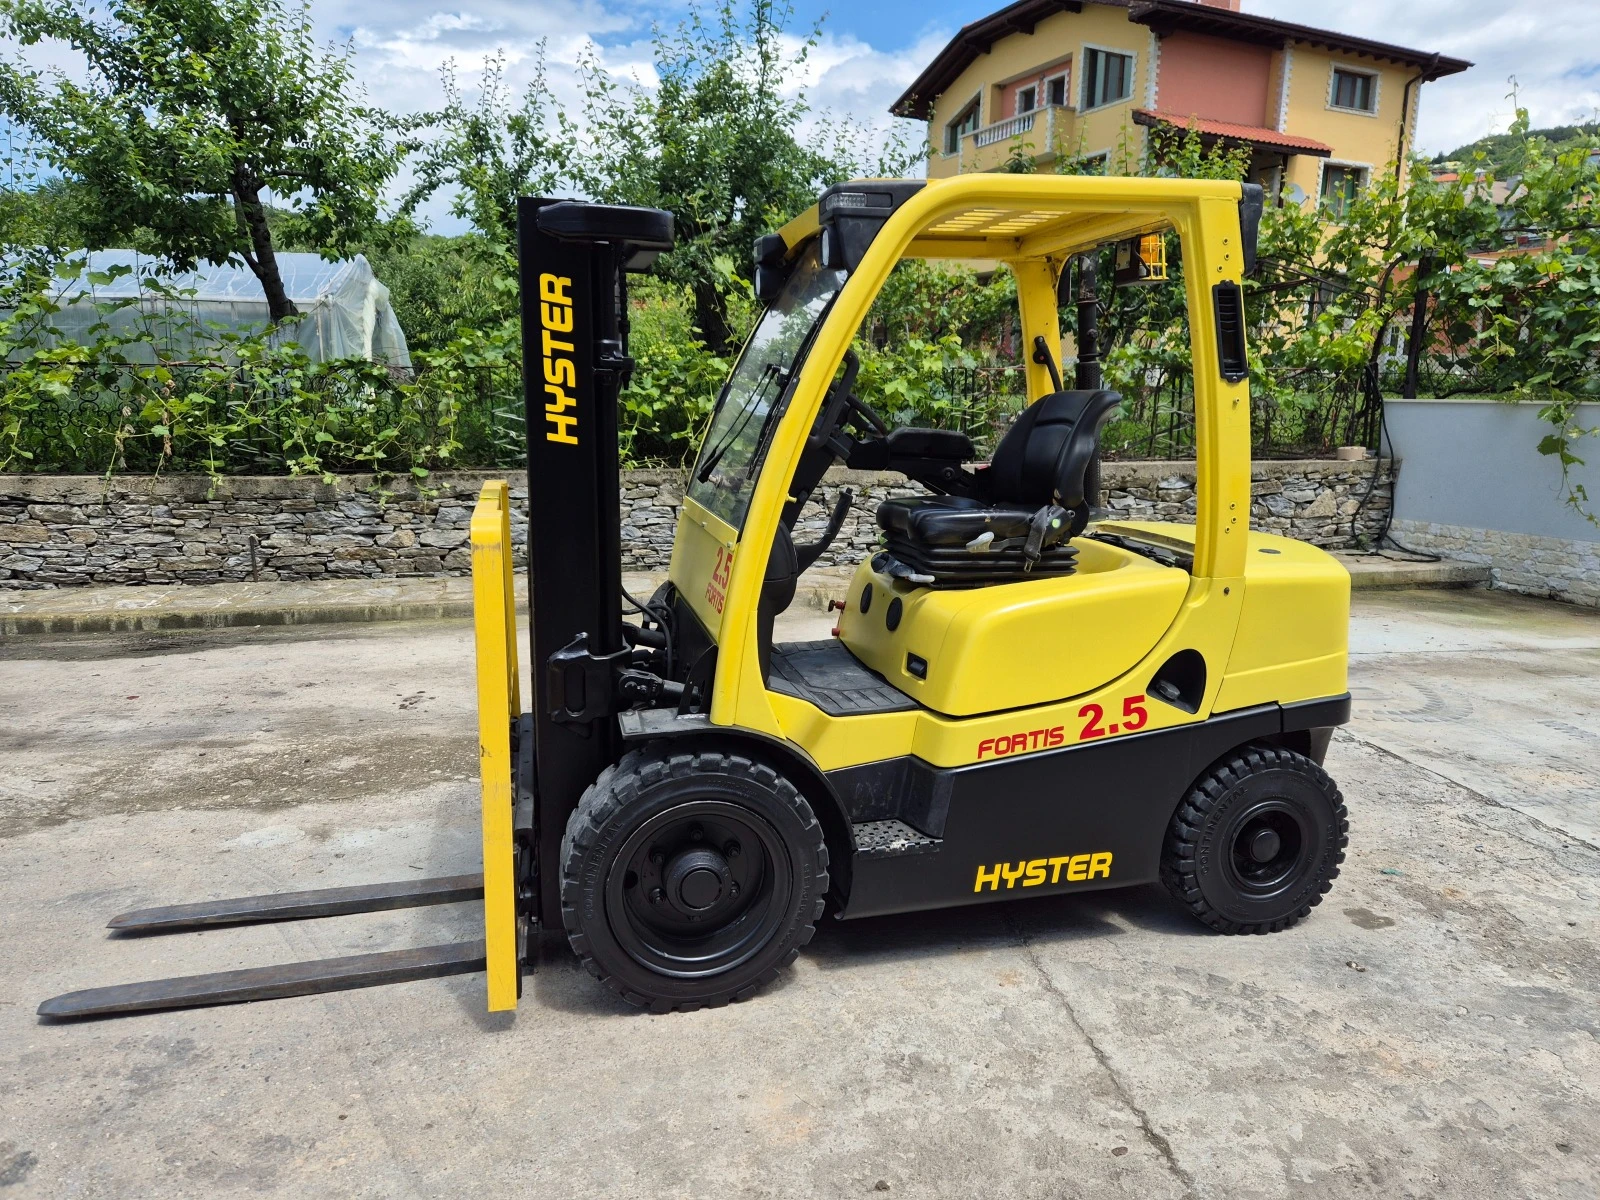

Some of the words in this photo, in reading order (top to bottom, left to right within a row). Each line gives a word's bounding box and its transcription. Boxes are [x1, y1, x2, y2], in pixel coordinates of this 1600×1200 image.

[540, 273, 578, 445] HYSTER
[712, 546, 733, 590] 2.5
[704, 582, 725, 615] FORTIS
[977, 725, 1065, 759] FORTIS
[1078, 694, 1148, 740] 2.5
[1201, 785, 1249, 875] CONTINENTAL
[973, 852, 1113, 893] HYSTER
